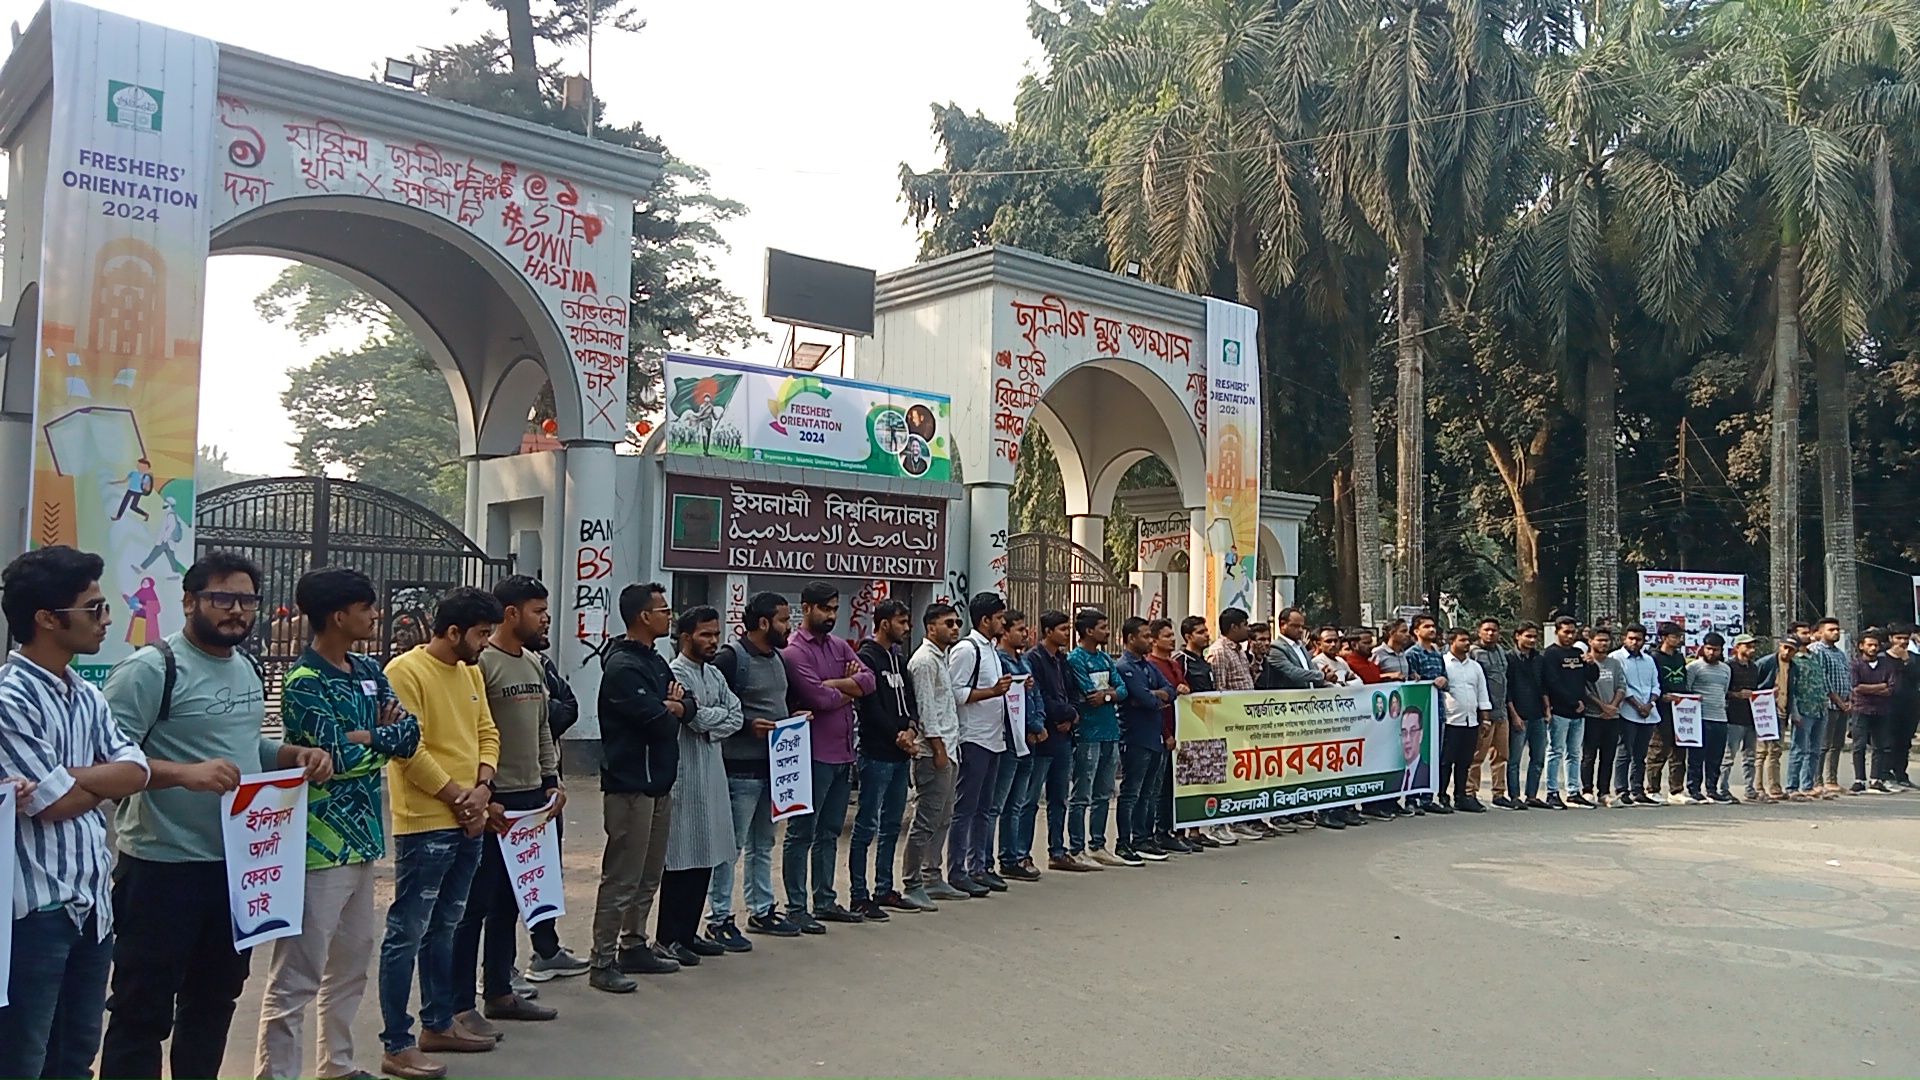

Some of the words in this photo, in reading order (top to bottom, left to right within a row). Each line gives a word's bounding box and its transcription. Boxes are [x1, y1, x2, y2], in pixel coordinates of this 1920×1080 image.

[79, 149, 186, 183] FRESHERS'
[62, 170, 198, 209] ORIENTATION
[102, 200, 160, 223] 2024
[506, 227, 572, 268] DOWN
[524, 255, 598, 295] HASINA
[565, 321, 625, 351] হাসিনার
[780, 415, 842, 432] ORIENTATION
[791, 404, 832, 418] FRESHERS'
[799, 430, 825, 444] 2024
[796, 456, 813, 464] Islamic
[840, 461, 868, 470] Bangladesh
[730, 482, 811, 518] ইসলামী
[824, 493, 940, 529] বিশ্ববিদ্যালয়
[728, 547, 815, 571] ISLAMIC
[825, 553, 939, 577] UNIVERSITY
[1244, 697, 1287, 719] আন্তর্জাতিক
[1289, 695, 1334, 716] মানবাধিকার
[1335, 694, 1356, 712] দিবস
[776, 735, 801, 752] চৌধুরী
[1232, 738, 1366, 781] মানববন্ধন
[776, 771, 800, 787] ফেরত
[779, 788, 794, 802] চাই
[1219, 791, 1270, 815] ইসলামী
[1273, 784, 1342, 807] বিশ্ববিদ্যালয়
[1345, 779, 1385, 798] ছাত্রদল
[245, 807, 294, 832] ইলিয়াস
[249, 832, 281, 859] আলী
[509, 822, 546, 847] ইলিয়াস
[516, 842, 541, 865] আলী
[241, 865, 283, 890] ফেরত
[517, 865, 546, 889] ফেরত
[247, 893, 272, 917] চাই
[523, 887, 541, 908] চাই
